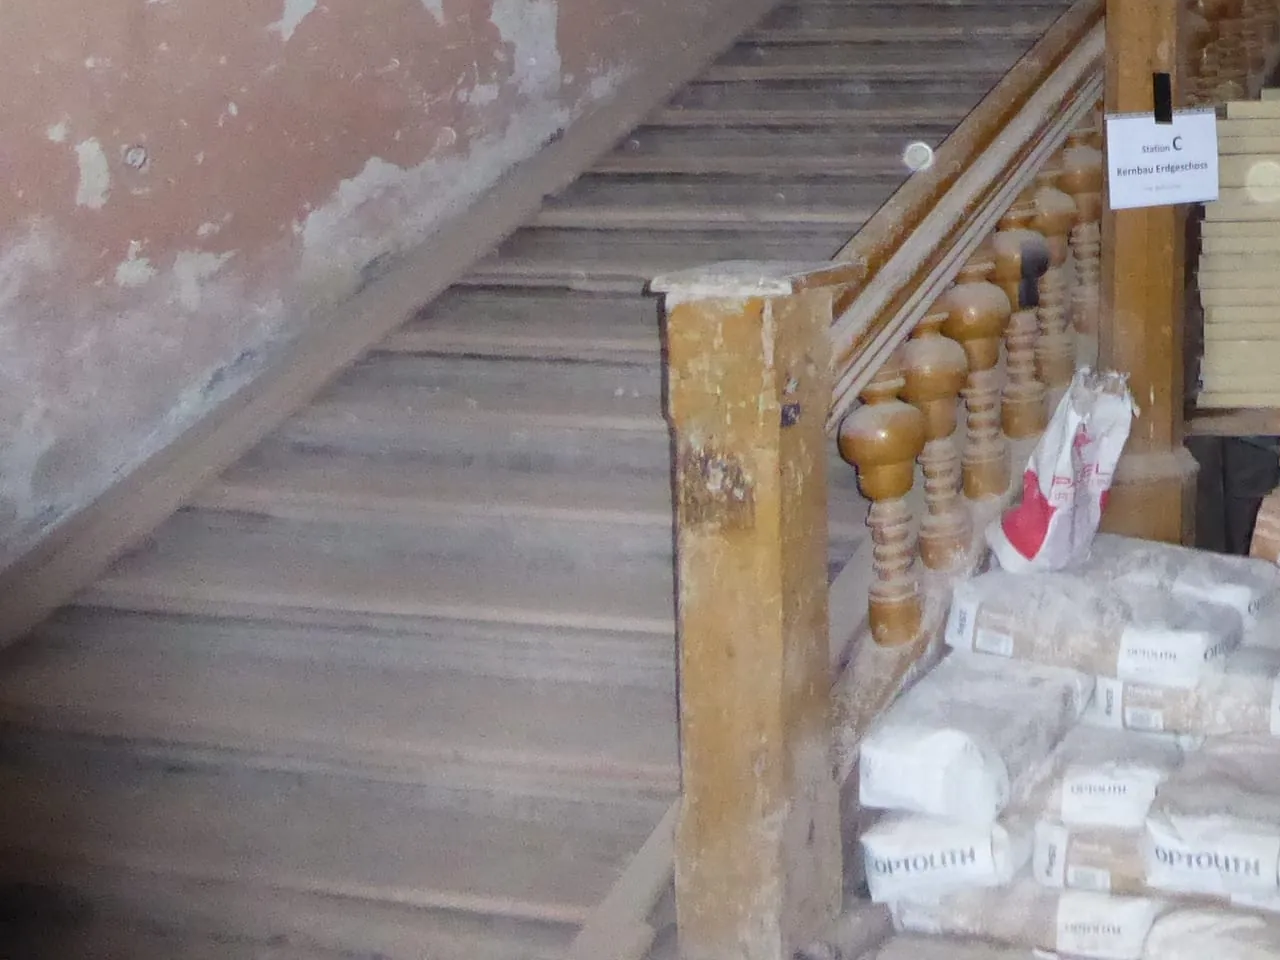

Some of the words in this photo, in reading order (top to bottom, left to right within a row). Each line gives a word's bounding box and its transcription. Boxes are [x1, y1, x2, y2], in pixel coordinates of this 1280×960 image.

[1142, 144, 1171, 154] Station
[1172, 136, 1183, 151] C
[1117, 165, 1154, 177] Kernbau
[1156, 161, 1208, 174] Erdgeschoss
[874, 846, 975, 874] OPTOLITH
[1155, 846, 1260, 876] OPTOLITH
